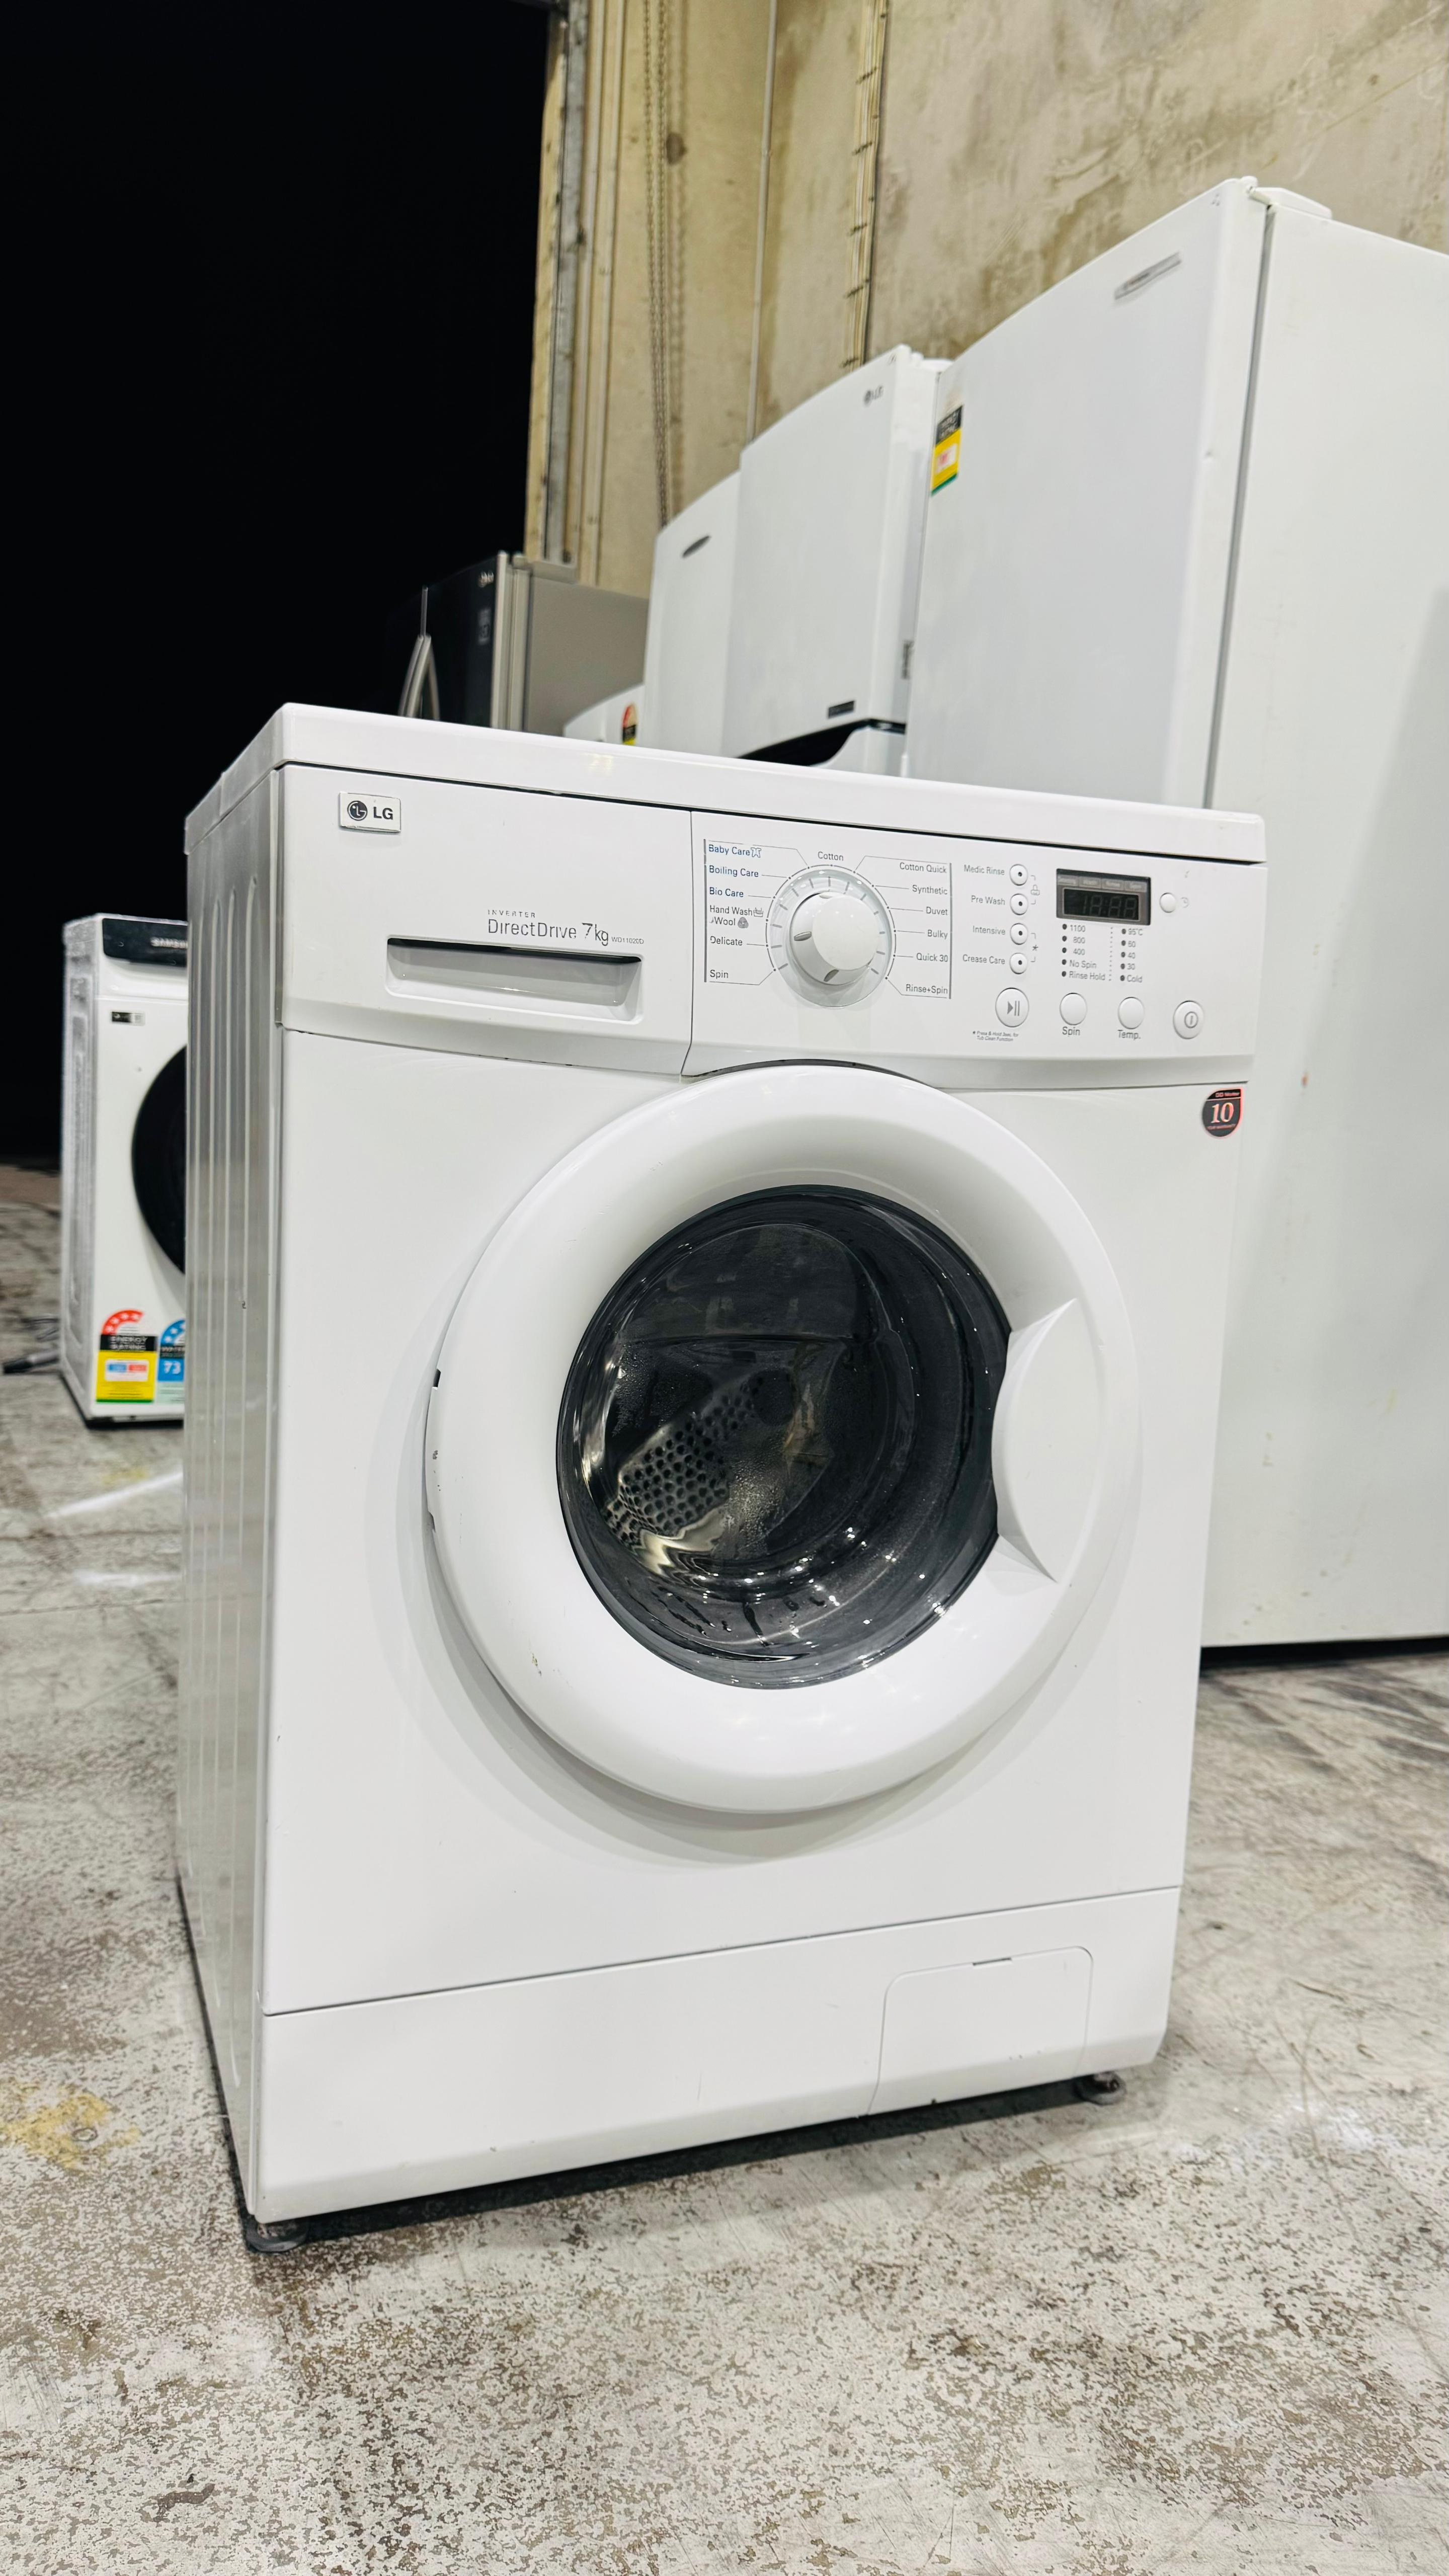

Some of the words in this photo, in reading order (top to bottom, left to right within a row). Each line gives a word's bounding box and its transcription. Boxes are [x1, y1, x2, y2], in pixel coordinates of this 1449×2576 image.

[373, 806, 393, 820] LG
[708, 844, 729, 855] Baby
[732, 847, 750, 856] Care
[818, 852, 843, 861] Cotton
[709, 865, 738, 877] Boiling
[741, 868, 759, 877] Care
[899, 862, 924, 872] Cotton
[926, 865, 947, 873] Quick
[964, 865, 985, 874] Medic
[987, 867, 1005, 875] Rinse
[709, 887, 723, 896] Bio
[725, 889, 744, 898] Care
[912, 885, 948, 896] Synthetic
[986, 897, 1005, 905] Wash
[488, 910, 535, 918] INVERTER
[709, 906, 730, 915] Hand
[732, 907, 753, 916] Wash
[926, 907, 948, 916] Duvet
[488, 919, 577, 939] DirectDrive
[582, 923, 608, 946] 7kg
[927, 929, 948, 939] Bulky
[972, 926, 1006, 935] Intensive
[710, 936, 743, 946] Delicate
[916, 953, 937, 961] Quick
[939, 954, 948, 962] 30
[962, 955, 987, 964] Crease
[989, 956, 1005, 965] Care
[1082, 960, 1097, 969] Spin
[710, 970, 729, 979] Spin
[1069, 971, 1087, 979] Rinse
[906, 984, 948, 995] Rinse+Spin
[1062, 1026, 1080, 1037] Spin
[1117, 1029, 1141, 1040] Temp.
[1211, 1102, 1234, 1123] 10
[164, 1361, 181, 1374] 73
